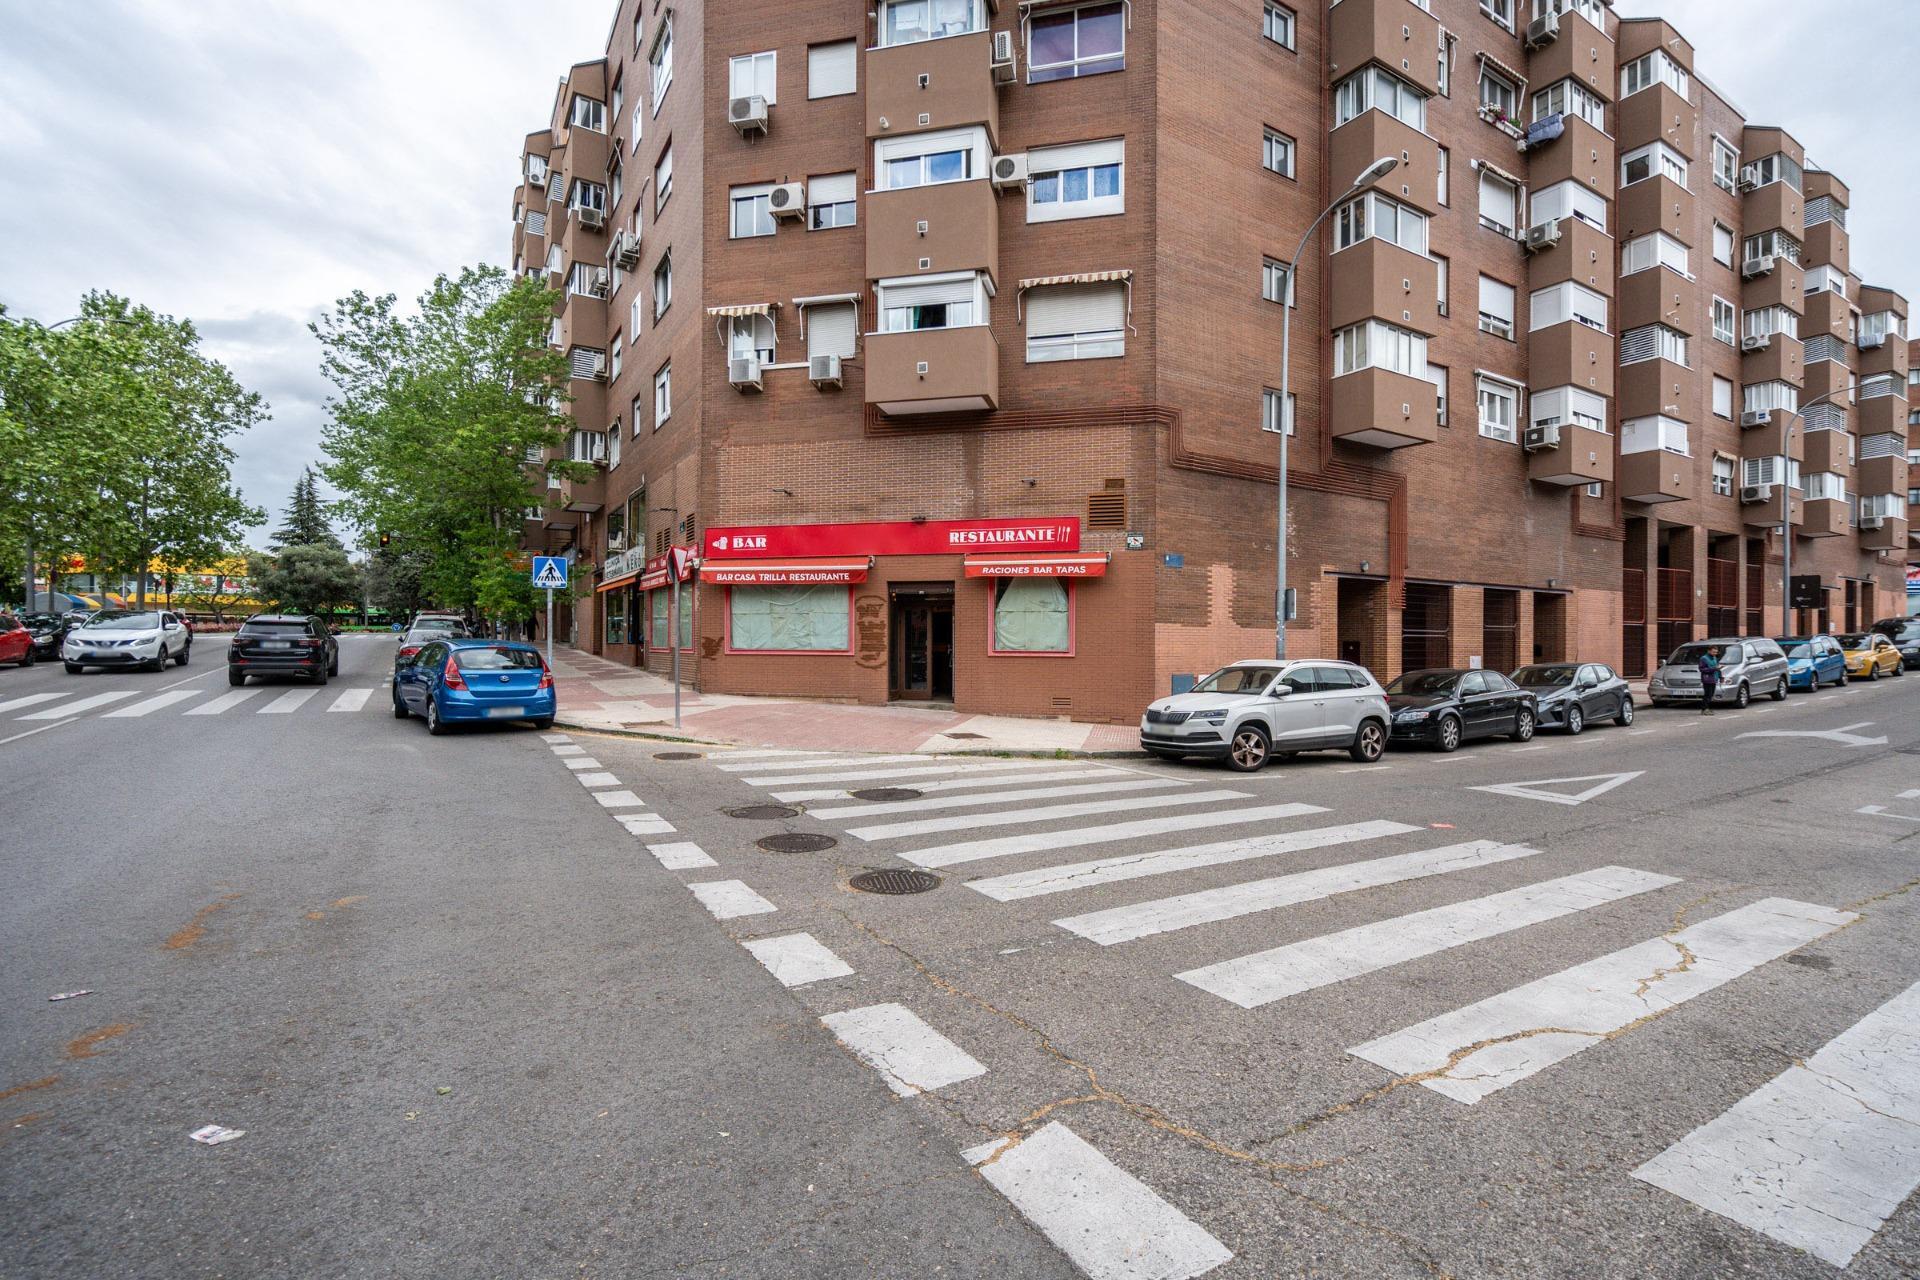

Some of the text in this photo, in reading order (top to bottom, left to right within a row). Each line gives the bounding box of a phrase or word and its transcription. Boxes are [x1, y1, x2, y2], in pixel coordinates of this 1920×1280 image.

[950, 528, 1055, 543] RESTAURANTE
[733, 537, 767, 548] BAR
[982, 566, 1030, 574] RACIONES
[1033, 566, 1052, 574] BAR
[734, 573, 756, 581] CASA
[759, 573, 786, 581] TRILLA
[789, 572, 850, 581] RESTAURANTE
